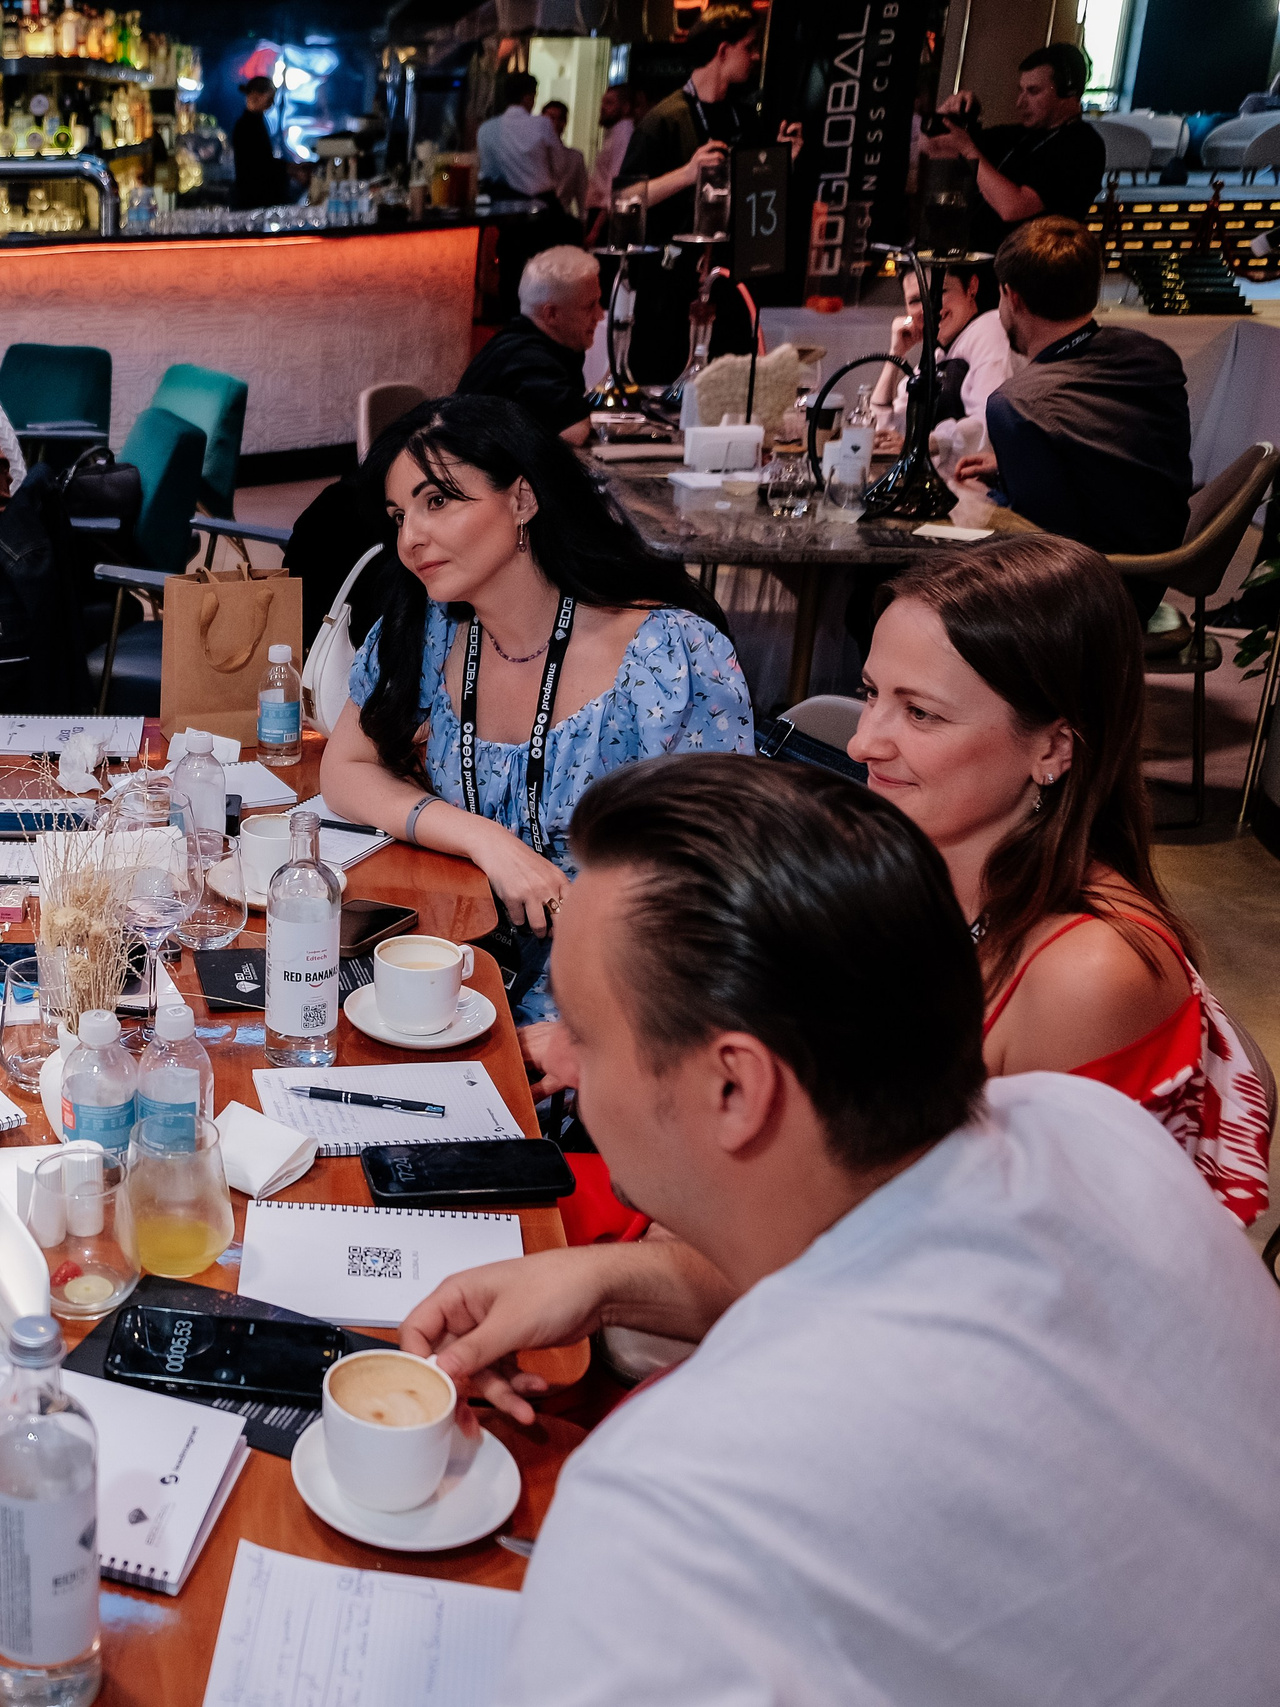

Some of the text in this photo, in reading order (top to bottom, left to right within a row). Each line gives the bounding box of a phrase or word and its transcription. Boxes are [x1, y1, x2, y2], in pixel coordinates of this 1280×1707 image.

[872, 2, 899, 92] CLUB
[811, 4, 871, 276] EDGLOBAL
[746, 190, 778, 237] 13
[464, 625, 479, 701] EDGLOBAL
[541, 662, 557, 711] prodamus
[283, 970, 302, 983] RED
[306, 954, 328, 962] Edtech
